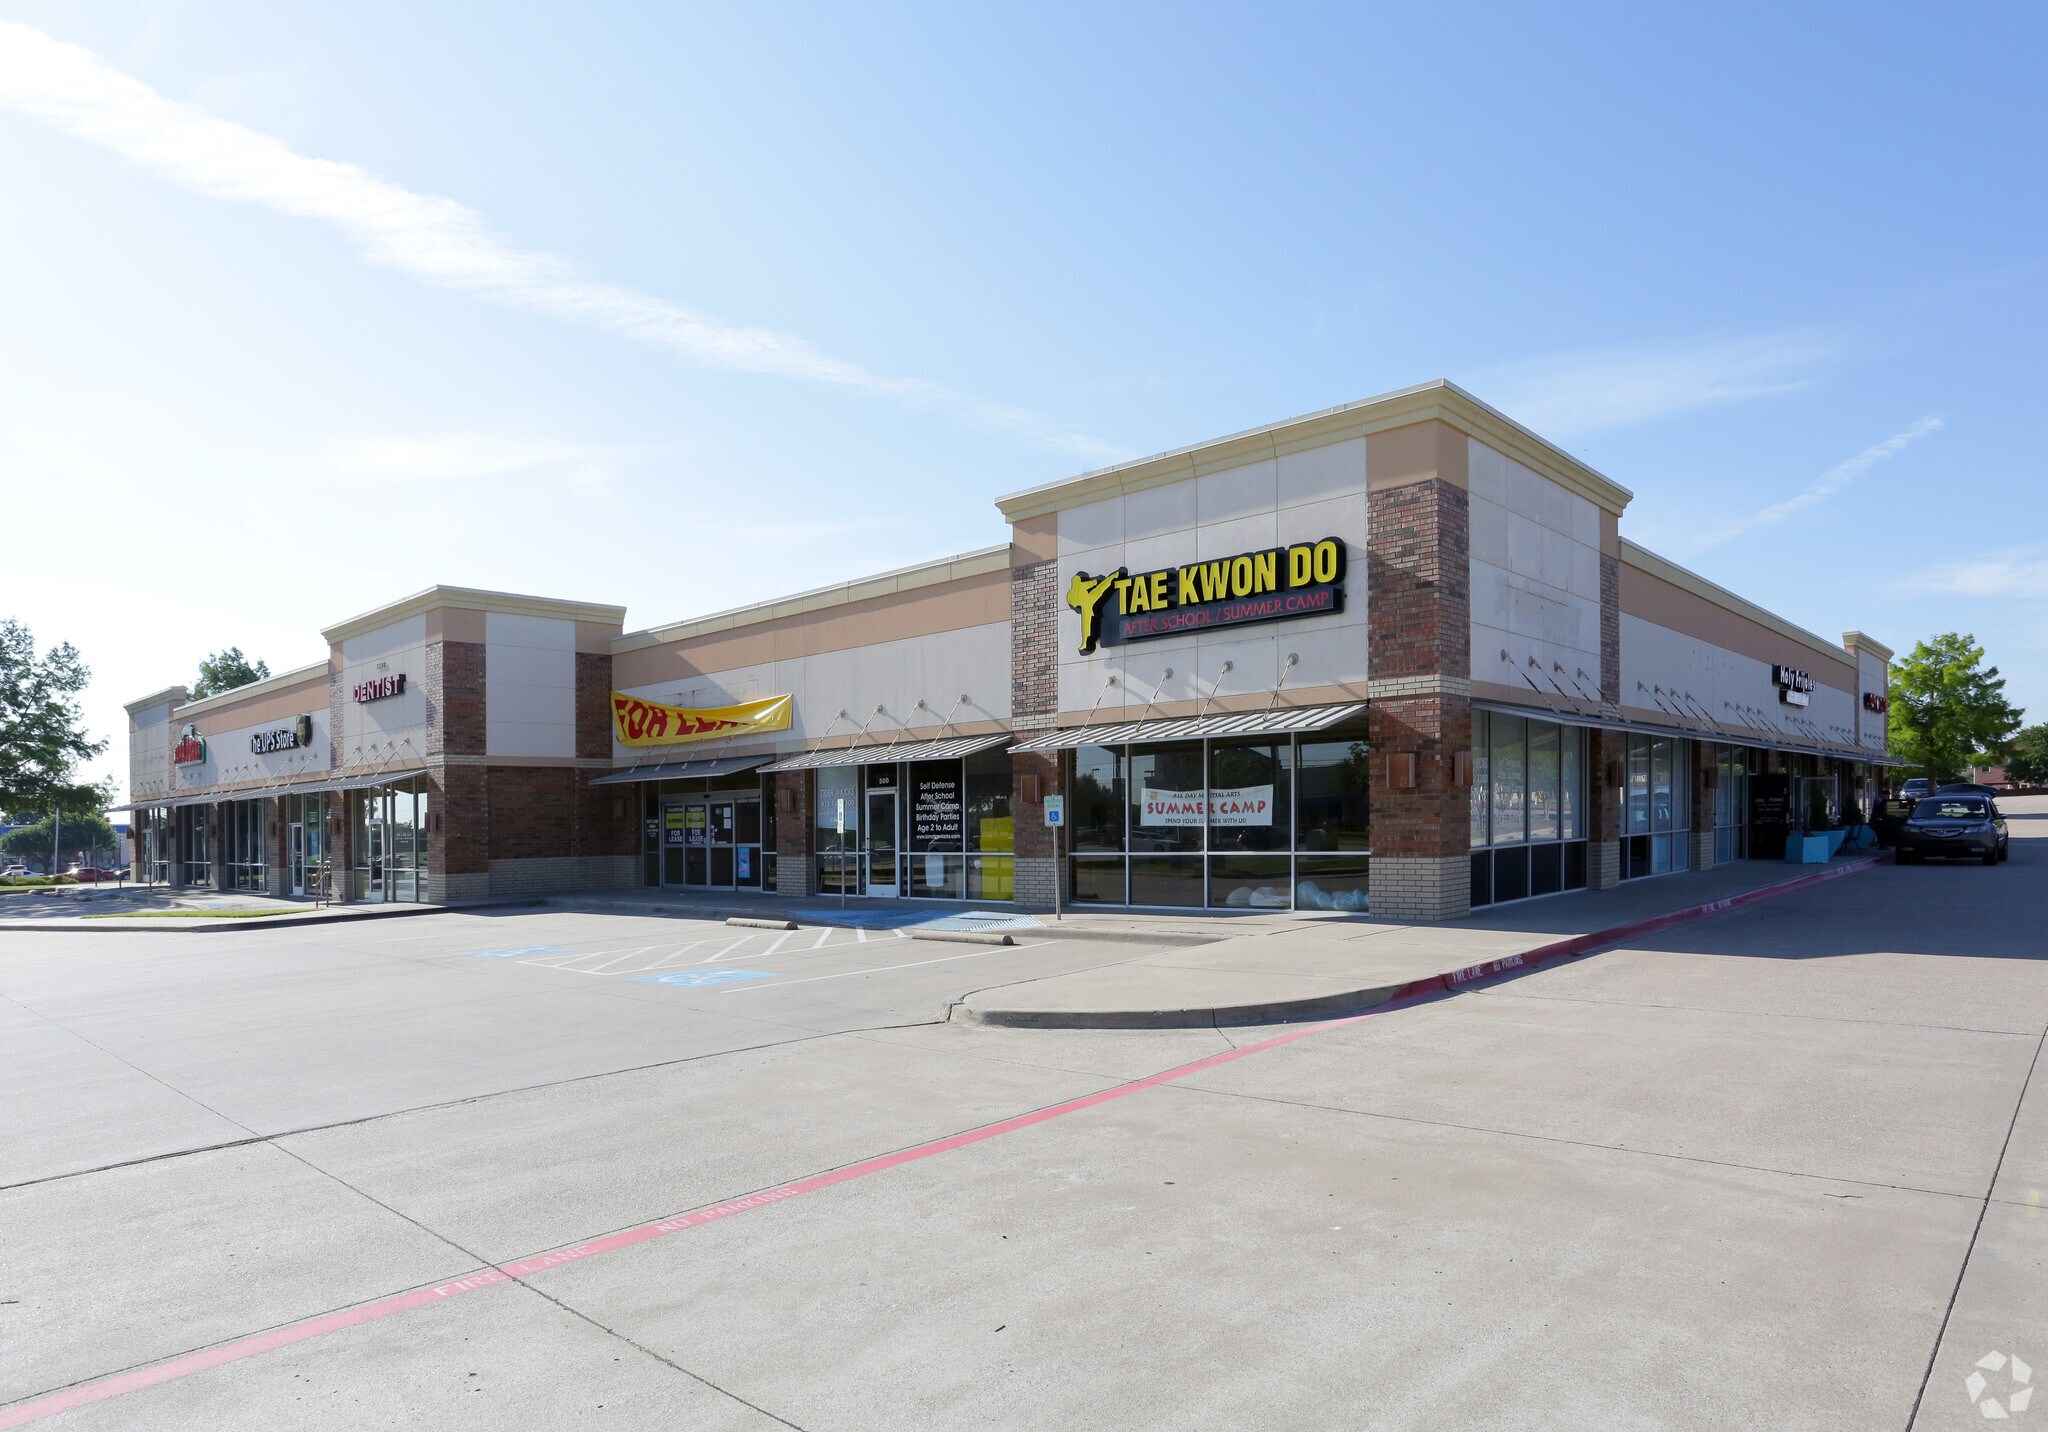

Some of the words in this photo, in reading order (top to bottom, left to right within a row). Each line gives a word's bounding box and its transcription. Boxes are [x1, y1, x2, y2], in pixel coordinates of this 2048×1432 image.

[1114, 571, 1168, 615] TAE
[1178, 551, 1276, 606] KWON
[1289, 540, 1337, 588] DO
[1123, 619, 1159, 636] AFTER
[1161, 611, 1213, 630] SCHOOL
[1223, 600, 1282, 621] SUMMER
[1286, 591, 1329, 611] CAMP
[1780, 665, 1794, 690] Holy
[353, 673, 400, 703] DENTIST
[614, 700, 668, 739] FOR
[261, 732, 276, 752] UPS
[276, 730, 295, 750] Store
[920, 782, 930, 790] Self
[931, 781, 955, 789] Defense
[920, 792, 934, 800] After
[935, 791, 955, 799] School
[916, 803, 940, 811] Summer
[940, 802, 960, 811] Camp
[1220, 800, 1266, 814] CAMP
[916, 813, 940, 822] Birthday
[917, 824, 930, 833] Age
[942, 823, 958, 831] Adult
[1501, 954, 1523, 969] PARKING
[433, 1268, 504, 1298] FIRE
[520, 1244, 591, 1272] LANE
[656, 1217, 692, 1233] NO
[699, 1187, 798, 1219] PARKING
